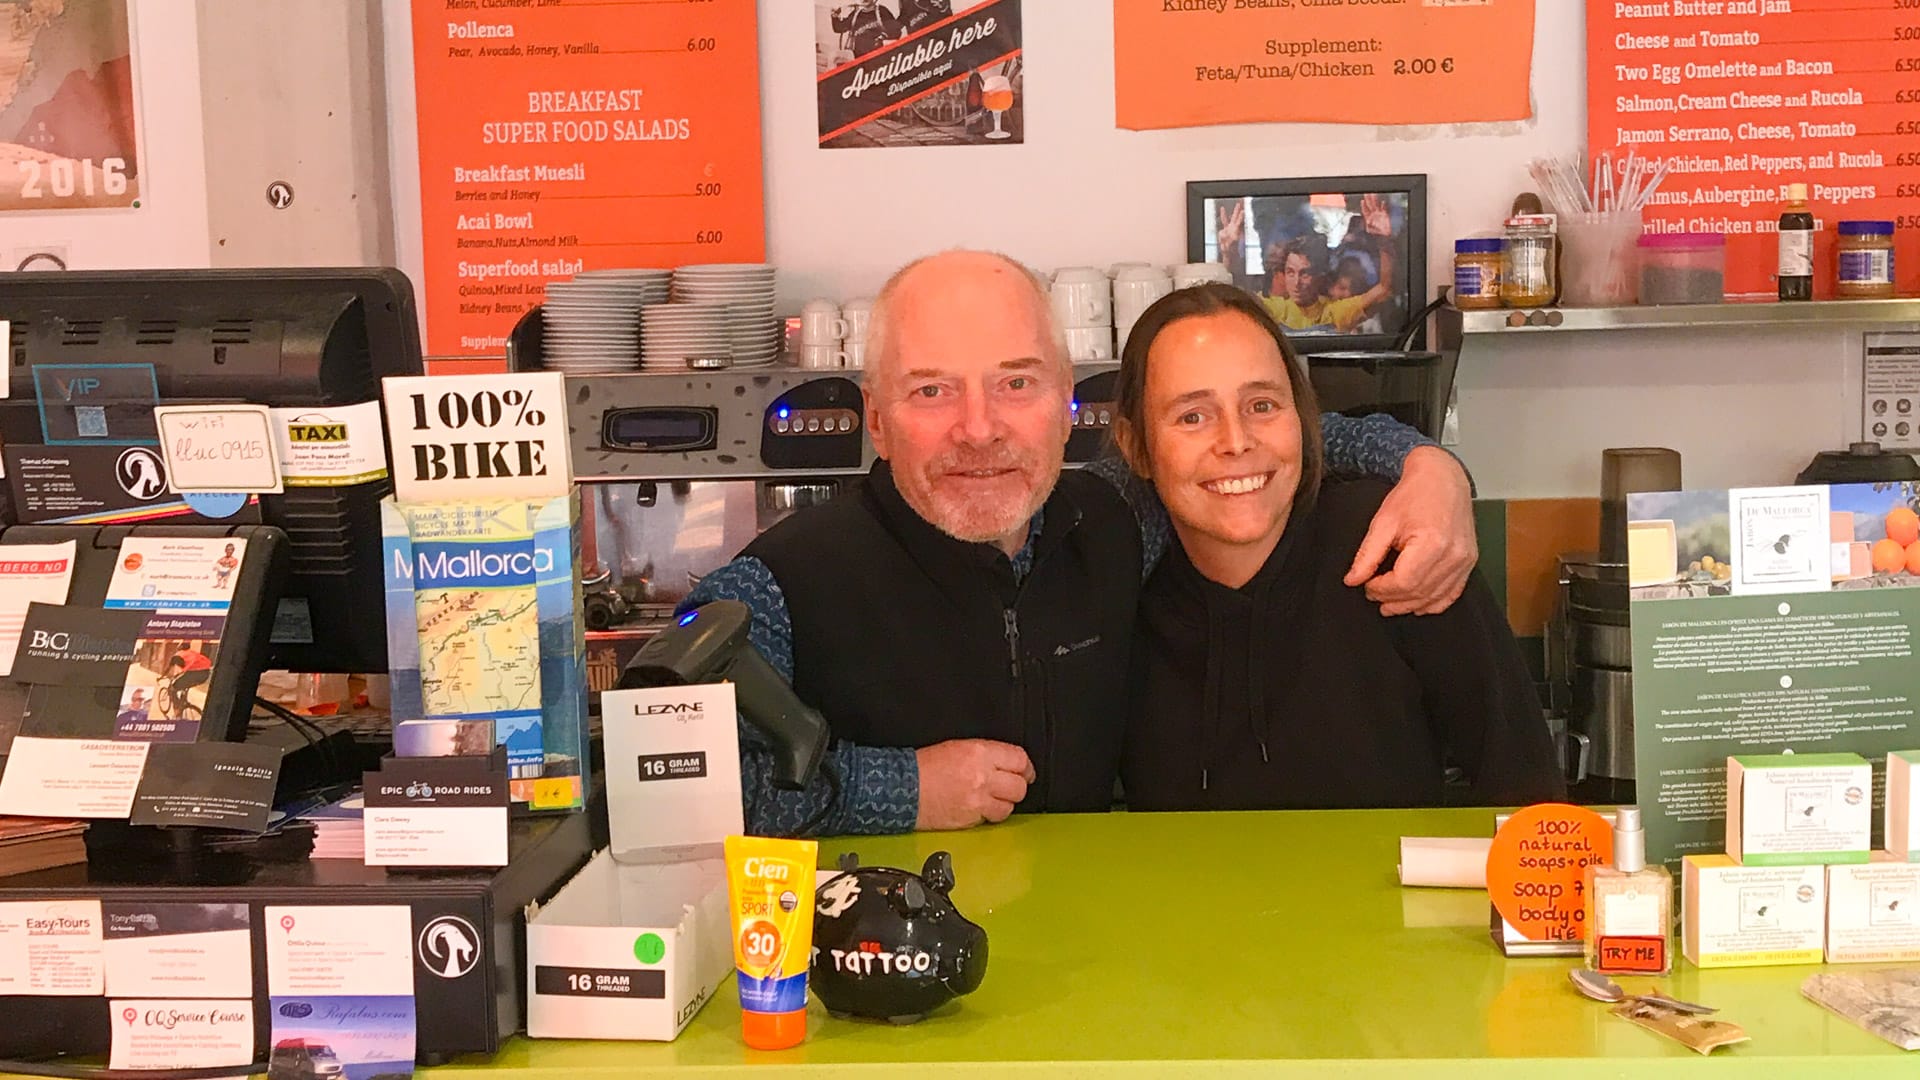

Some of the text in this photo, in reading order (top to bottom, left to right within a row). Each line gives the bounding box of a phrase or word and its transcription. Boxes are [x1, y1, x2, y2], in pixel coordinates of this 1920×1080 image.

[1615, 0, 1792, 18] Peanut Butter and Jam
[687, 38, 716, 52] 6.00
[1266, 38, 1383, 56] Supplement:
[1615, 30, 1760, 50] Cheese and Tomato
[448, 42, 600, 58] Pear, Avocado, Honey, Vanilla
[842, 17, 998, 99] Available here
[1195, 58, 1454, 82] Feta/Tuna/Chicken 2.00 €
[1616, 59, 1834, 84] Two Egg Omelette and Bacon
[887, 67, 933, 96] Disponible
[528, 90, 643, 113] BREAKFAST
[1730, 91, 1782, 108] Cheese
[1784, 93, 1807, 106] and
[1810, 88, 1863, 106] Rucola
[482, 118, 690, 144] SUPER FOOD SALADS
[1616, 121, 1856, 146] Jamon Serrano, Cheese, Tomato
[1617, 154, 1661, 174] Glled
[1751, 152, 1806, 175] Peppers,
[1808, 153, 1834, 170] and
[1839, 150, 1884, 168] Rucola
[18, 157, 128, 198] 2016
[454, 163, 586, 183] Breakfast Muesli
[455, 190, 541, 202] Berries and Honey
[695, 184, 722, 197] 5.00
[1814, 184, 1876, 204] Peppers
[456, 212, 534, 230] Acai Bowl
[1642, 218, 1684, 234] rilled
[1689, 216, 1752, 236] Chicken
[558, 235, 578, 246] Milk
[696, 230, 722, 244] 6.00
[458, 258, 583, 280] Superfood salad
[526, 284, 546, 294] Leav
[460, 303, 525, 315] Kidney Beans,
[460, 336, 507, 350] Supplem
[56, 378, 100, 401] VIP
[410, 390, 546, 430] 100%
[292, 425, 346, 440] TAXI
[222, 440, 264, 460] 0915
[411, 440, 548, 481] BIKE
[418, 548, 554, 580] Mallorca
[147, 620, 169, 629] Antony
[28, 650, 60, 660] running
[72, 652, 101, 662] cycling
[102, 654, 134, 662] analysi
[634, 702, 704, 716] LEZYNE
[644, 758, 700, 777] 16 GRAM
[380, 786, 402, 795] EPIC
[434, 786, 492, 794] ROAD RIDES
[1536, 820, 1582, 836] 100%
[1519, 837, 1592, 852] natural
[744, 857, 789, 880] Cien
[1514, 882, 1562, 908] soap
[742, 903, 774, 916] SPORT
[1519, 904, 1570, 929] body
[26, 918, 90, 935] Easy-Tours
[747, 932, 775, 956] 30
[1604, 948, 1655, 961] TRY ME
[568, 974, 630, 992] 16 GRAM
[676, 986, 706, 1026] LEZYNE
[208, 1009, 246, 1026] Course
